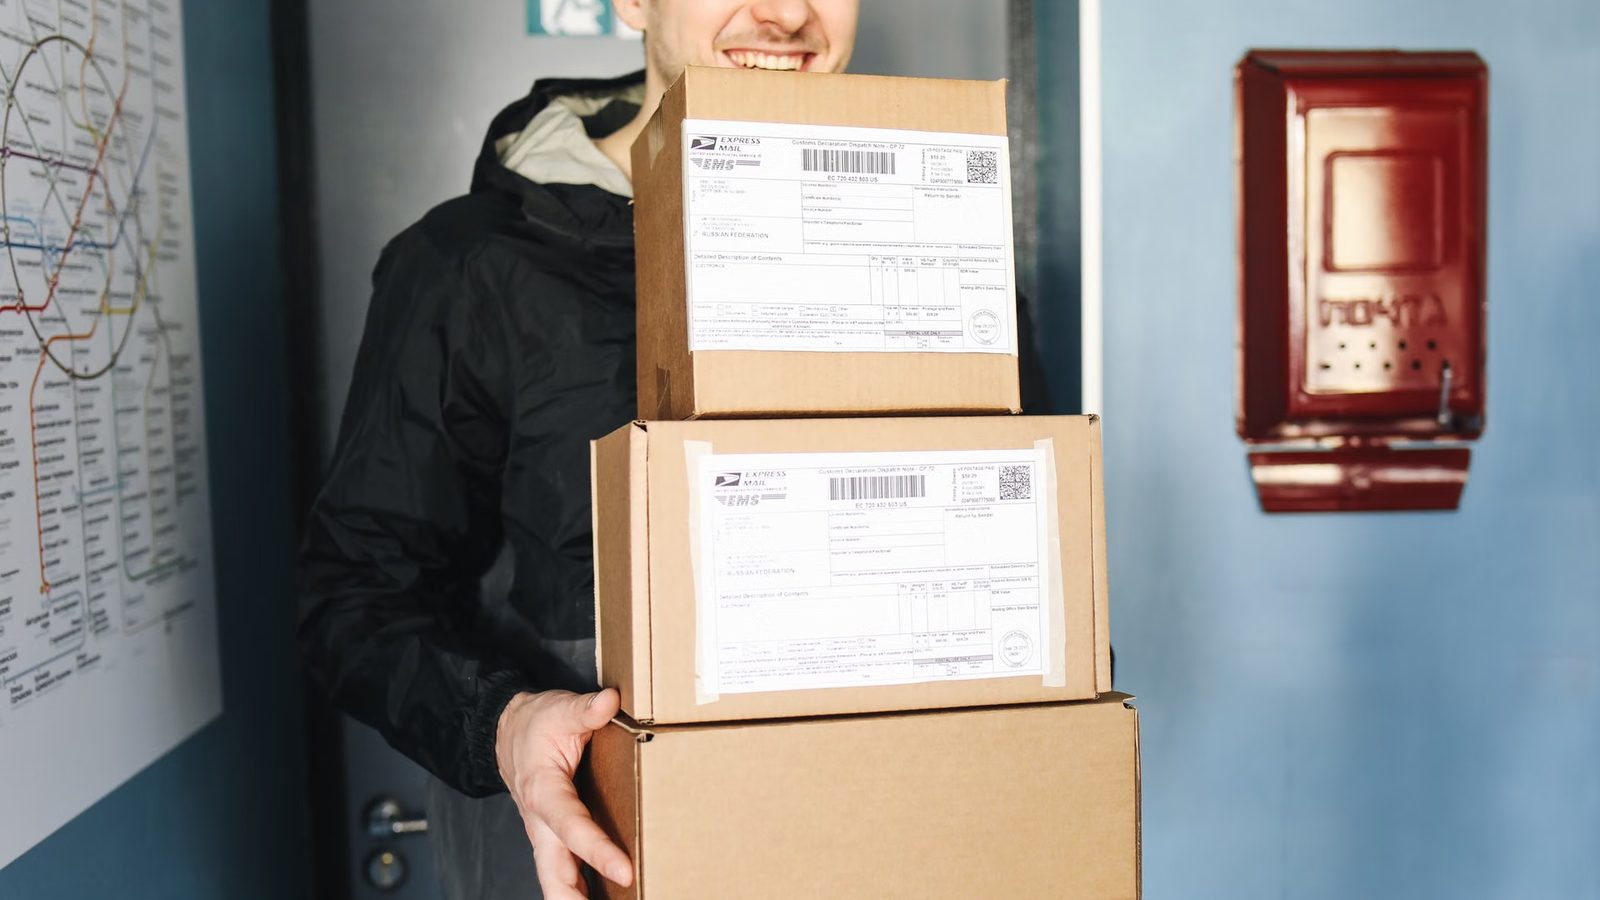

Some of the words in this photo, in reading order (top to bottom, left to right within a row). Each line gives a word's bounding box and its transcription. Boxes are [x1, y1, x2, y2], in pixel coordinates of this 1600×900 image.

[702, 158, 735, 171] EMS
[1319, 297, 1448, 328] ПОЧТА
[727, 494, 760, 507] EMS
